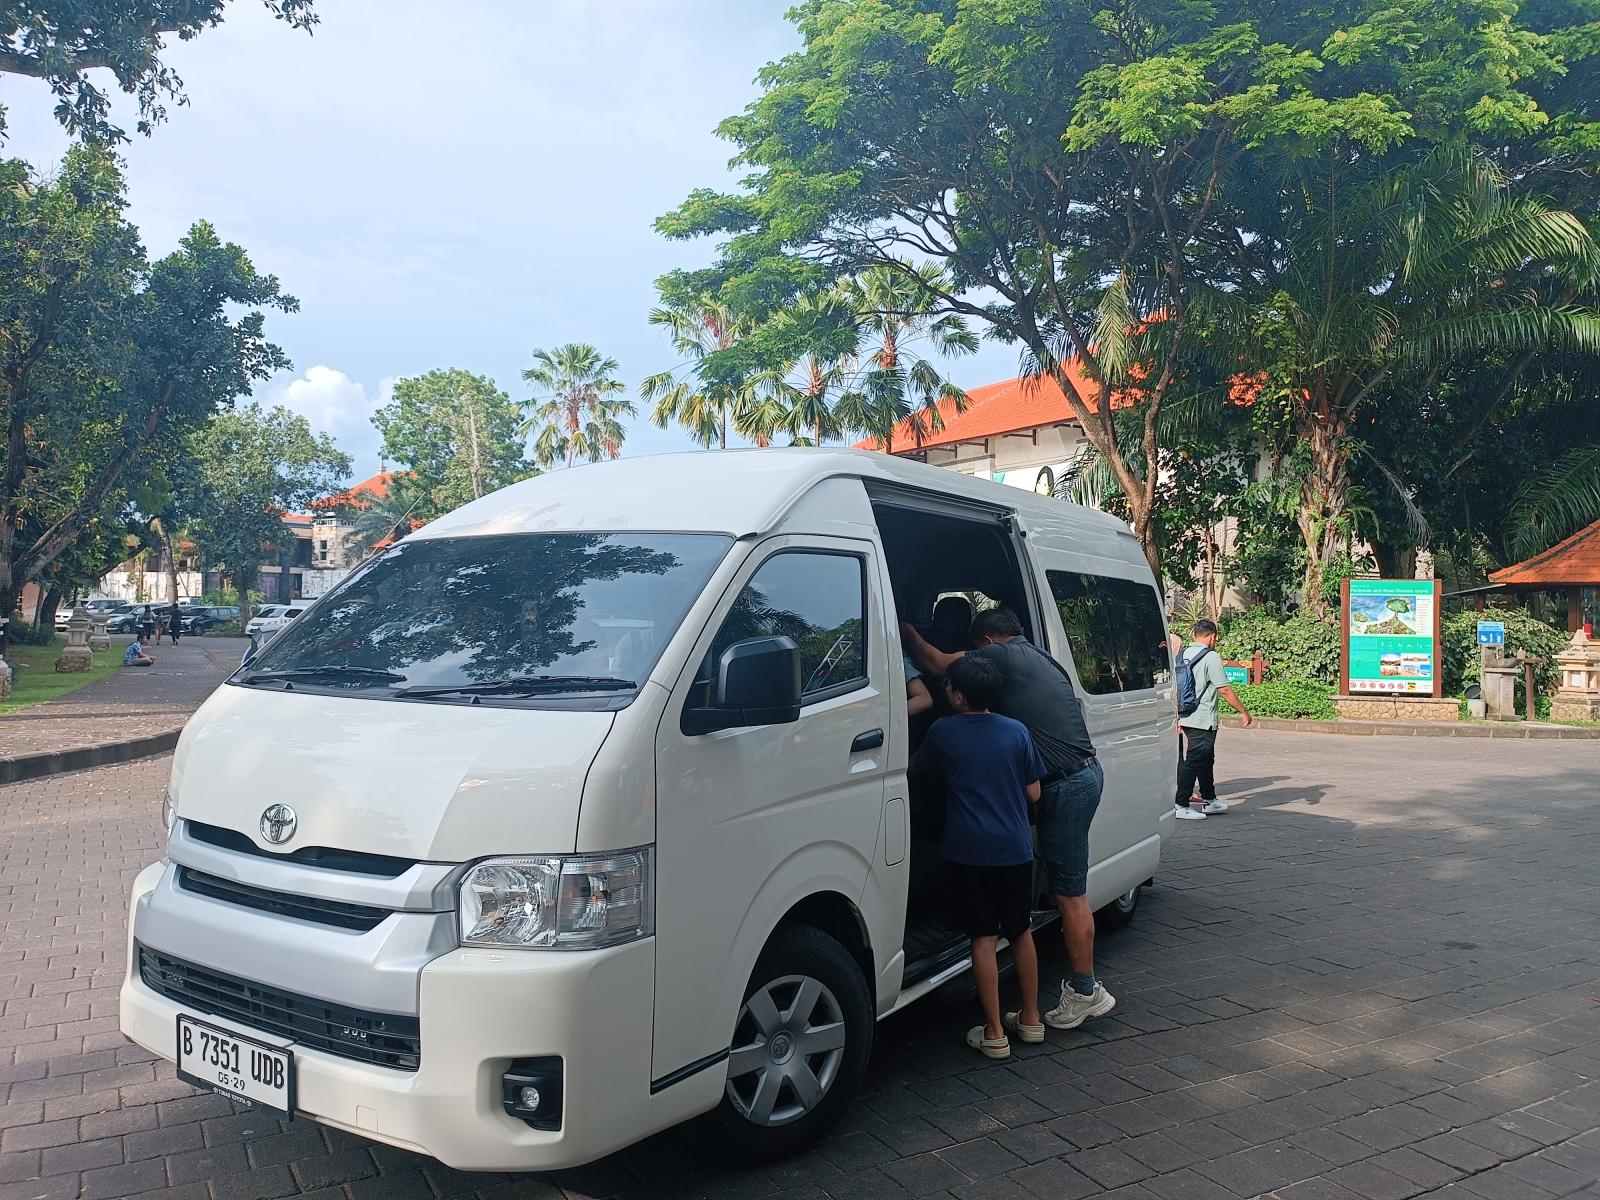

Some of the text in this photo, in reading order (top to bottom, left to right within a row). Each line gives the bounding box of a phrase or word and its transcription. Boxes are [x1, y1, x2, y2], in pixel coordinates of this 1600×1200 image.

[183, 1025, 285, 1090] B 7351 UDB
